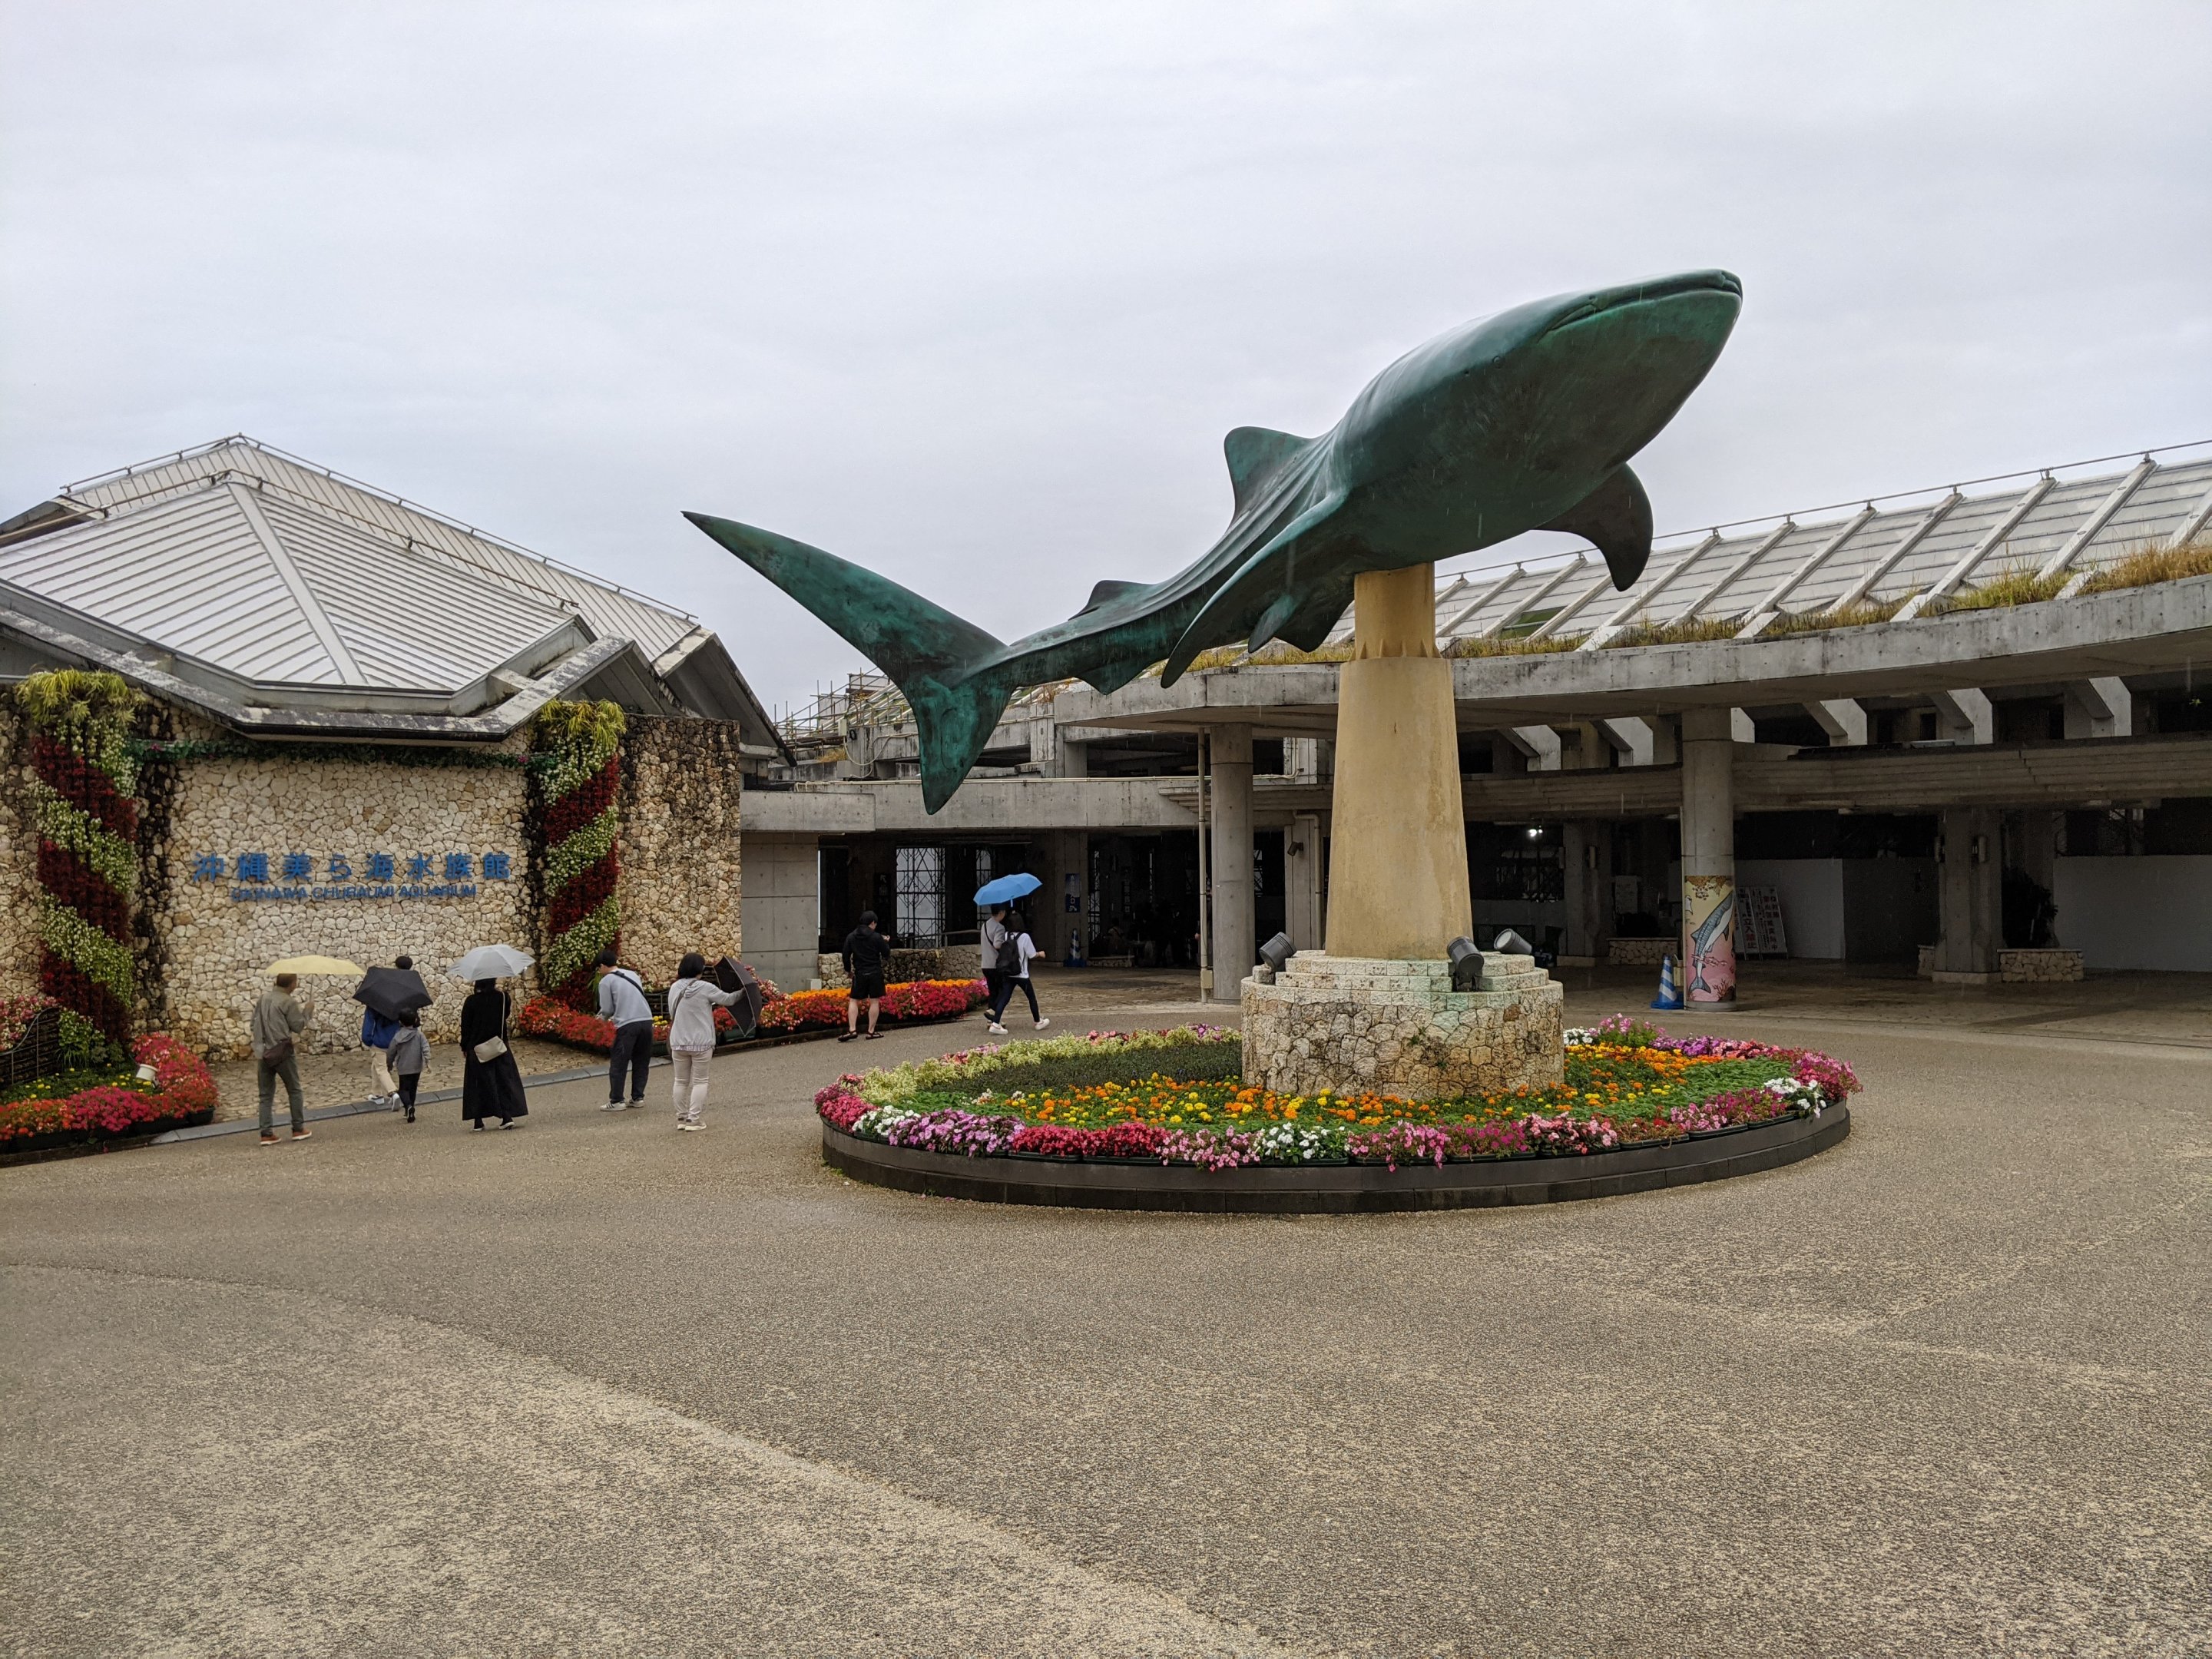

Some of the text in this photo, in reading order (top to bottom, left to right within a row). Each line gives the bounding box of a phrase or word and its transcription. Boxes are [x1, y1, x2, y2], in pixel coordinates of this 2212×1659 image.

[192, 851, 510, 882] 沖縄美ら海水族館
[232, 883, 477, 901] OKINAWA CHURAUMI AQUARIUM
